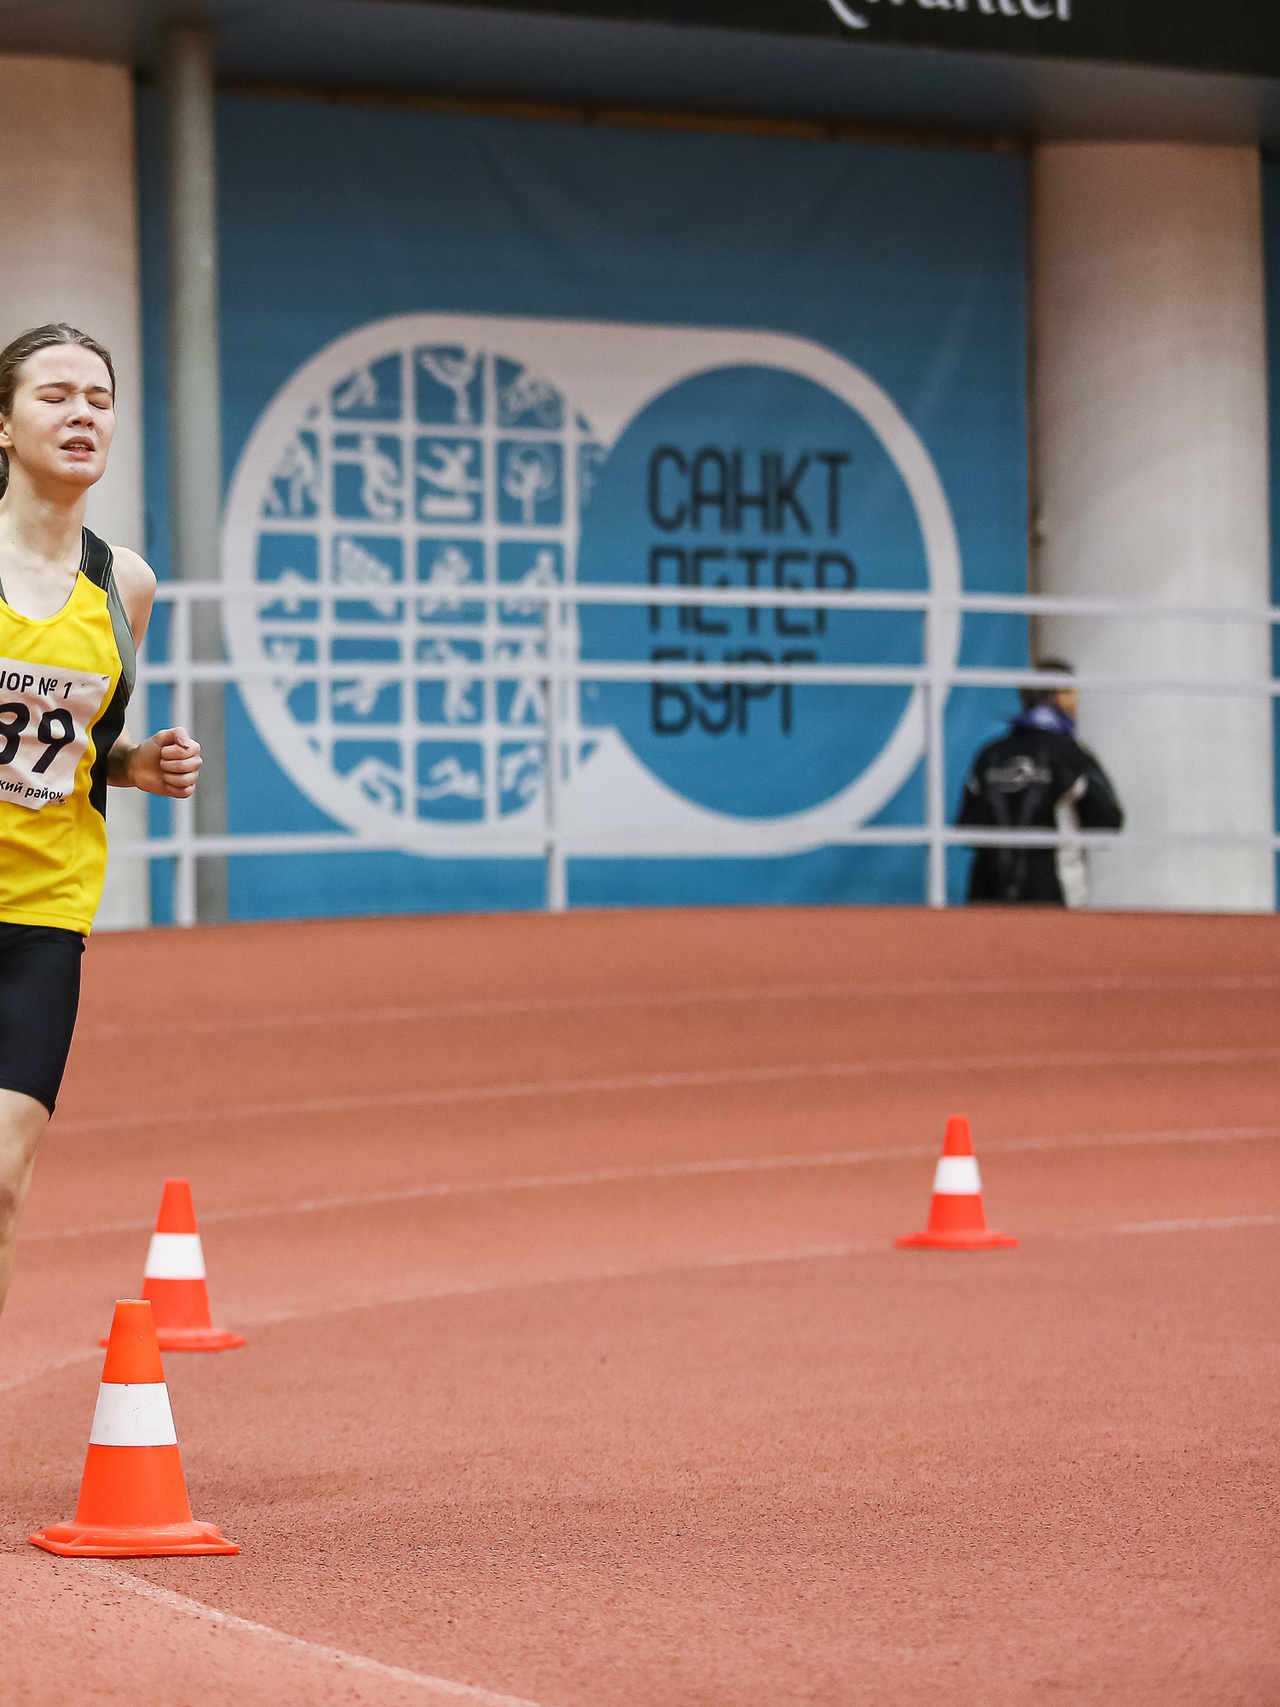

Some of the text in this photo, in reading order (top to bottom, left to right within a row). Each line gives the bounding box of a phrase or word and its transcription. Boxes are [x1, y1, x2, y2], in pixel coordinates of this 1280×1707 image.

[647, 445, 853, 533] САНКТ
[648, 546, 858, 635] ПЕТЕР
[62, 681, 73, 699] 1
[650, 647, 818, 737] БУРГ
